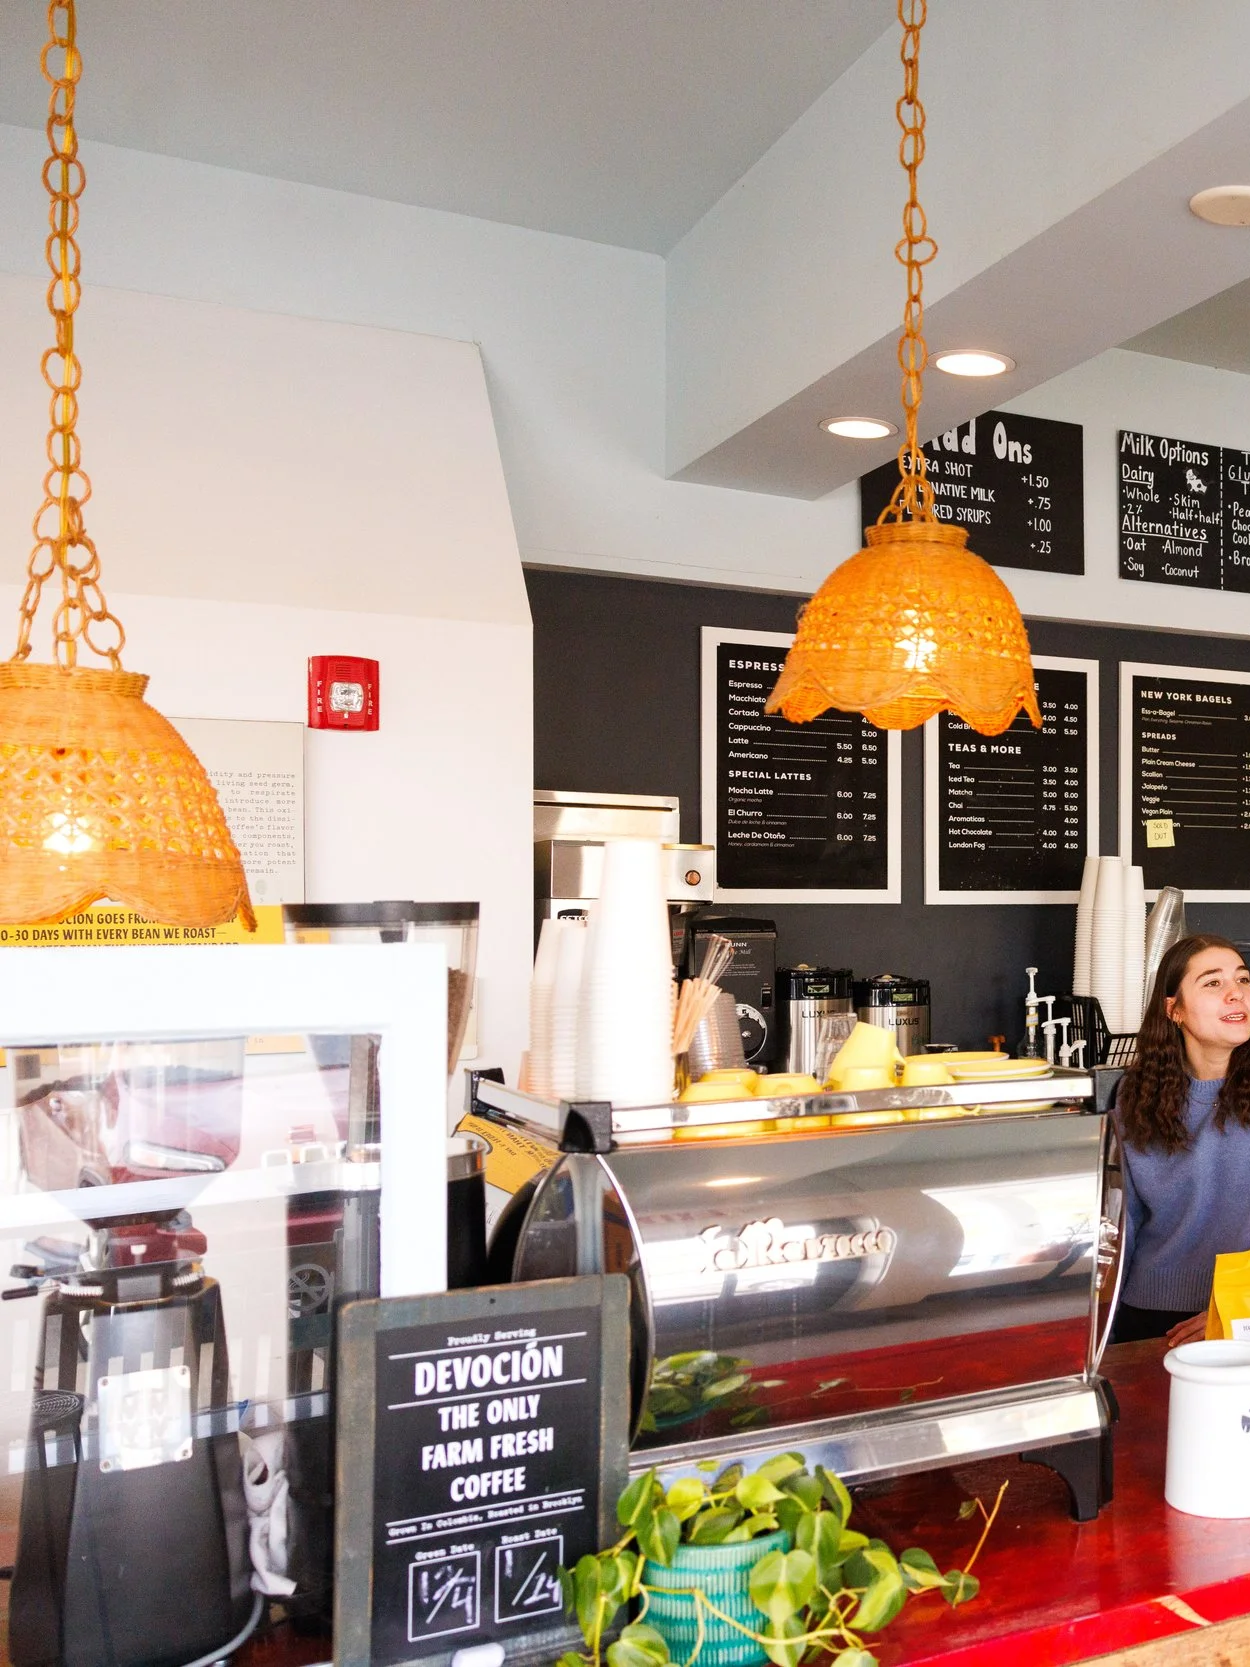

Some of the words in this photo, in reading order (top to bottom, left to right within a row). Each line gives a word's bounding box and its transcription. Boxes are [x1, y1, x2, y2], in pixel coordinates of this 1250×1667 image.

[993, 421, 1032, 464] Ons
[1121, 433, 1155, 457] Milk
[1160, 439, 1209, 466] Options
[900, 456, 939, 473] EXTRA
[945, 462, 973, 477] SHOT
[1021, 474, 1049, 487] +1.50
[1122, 464, 1154, 489] Dairy
[971, 488, 995, 503] MILK
[1028, 497, 1051, 510] +.75
[1126, 486, 1160, 503] Whole
[1174, 494, 1200, 508] Skim
[1127, 504, 1143, 514] 2%
[956, 508, 991, 524] SYRUPS
[1027, 518, 1051, 532] +1.00
[1122, 514, 1207, 540] Alternatives
[1030, 541, 1051, 553] +.25
[1127, 538, 1146, 551] Oat
[1164, 540, 1202, 557] Almond
[1127, 557, 1144, 577] Soy
[1165, 563, 1199, 578] Coconut
[728, 680, 763, 689] Espresso
[728, 694, 766, 703] Macchiato
[1141, 690, 1163, 699] NEW
[1167, 693, 1192, 701] YORK
[1196, 695, 1232, 704] BAGELS
[728, 709, 759, 717] Cortado
[1141, 708, 1175, 718] Ess-a-Bagel
[728, 723, 771, 732] Cappuccino
[1142, 732, 1176, 740] SPREADS
[948, 743, 976, 753] TEAS
[980, 744, 987, 753] &
[991, 745, 1022, 754] MORE
[728, 751, 768, 760] Americano
[1156, 759, 1174, 767] Cream
[729, 770, 771, 779] SPECIAL
[775, 772, 812, 781] LATTES
[1142, 796, 1160, 804] Veggie
[736, 809, 763, 817] Churro
[1142, 808, 1159, 816] Vegan
[763, 832, 785, 840] Otoño
[974, 842, 985, 850] Fog
[97, 913, 125, 924] GOES
[32, 929, 60, 941] DAYS
[63, 929, 93, 940] WITH
[96, 928, 129, 940] EVERY
[132, 928, 161, 939] BEAN
[163, 928, 181, 939] WE
[447, 1333, 491, 1348] Proudly
[494, 1328, 536, 1339] Serving
[414, 1341, 563, 1396] DEVOCIÓN
[438, 1402, 480, 1432] THE
[487, 1394, 541, 1424] ONLY
[422, 1438, 483, 1471] FARM
[490, 1427, 554, 1460] FRESH
[450, 1467, 526, 1502] COFFEE
[542, 1496, 583, 1510] Brooklyn
[501, 1533, 530, 1544] Roast
